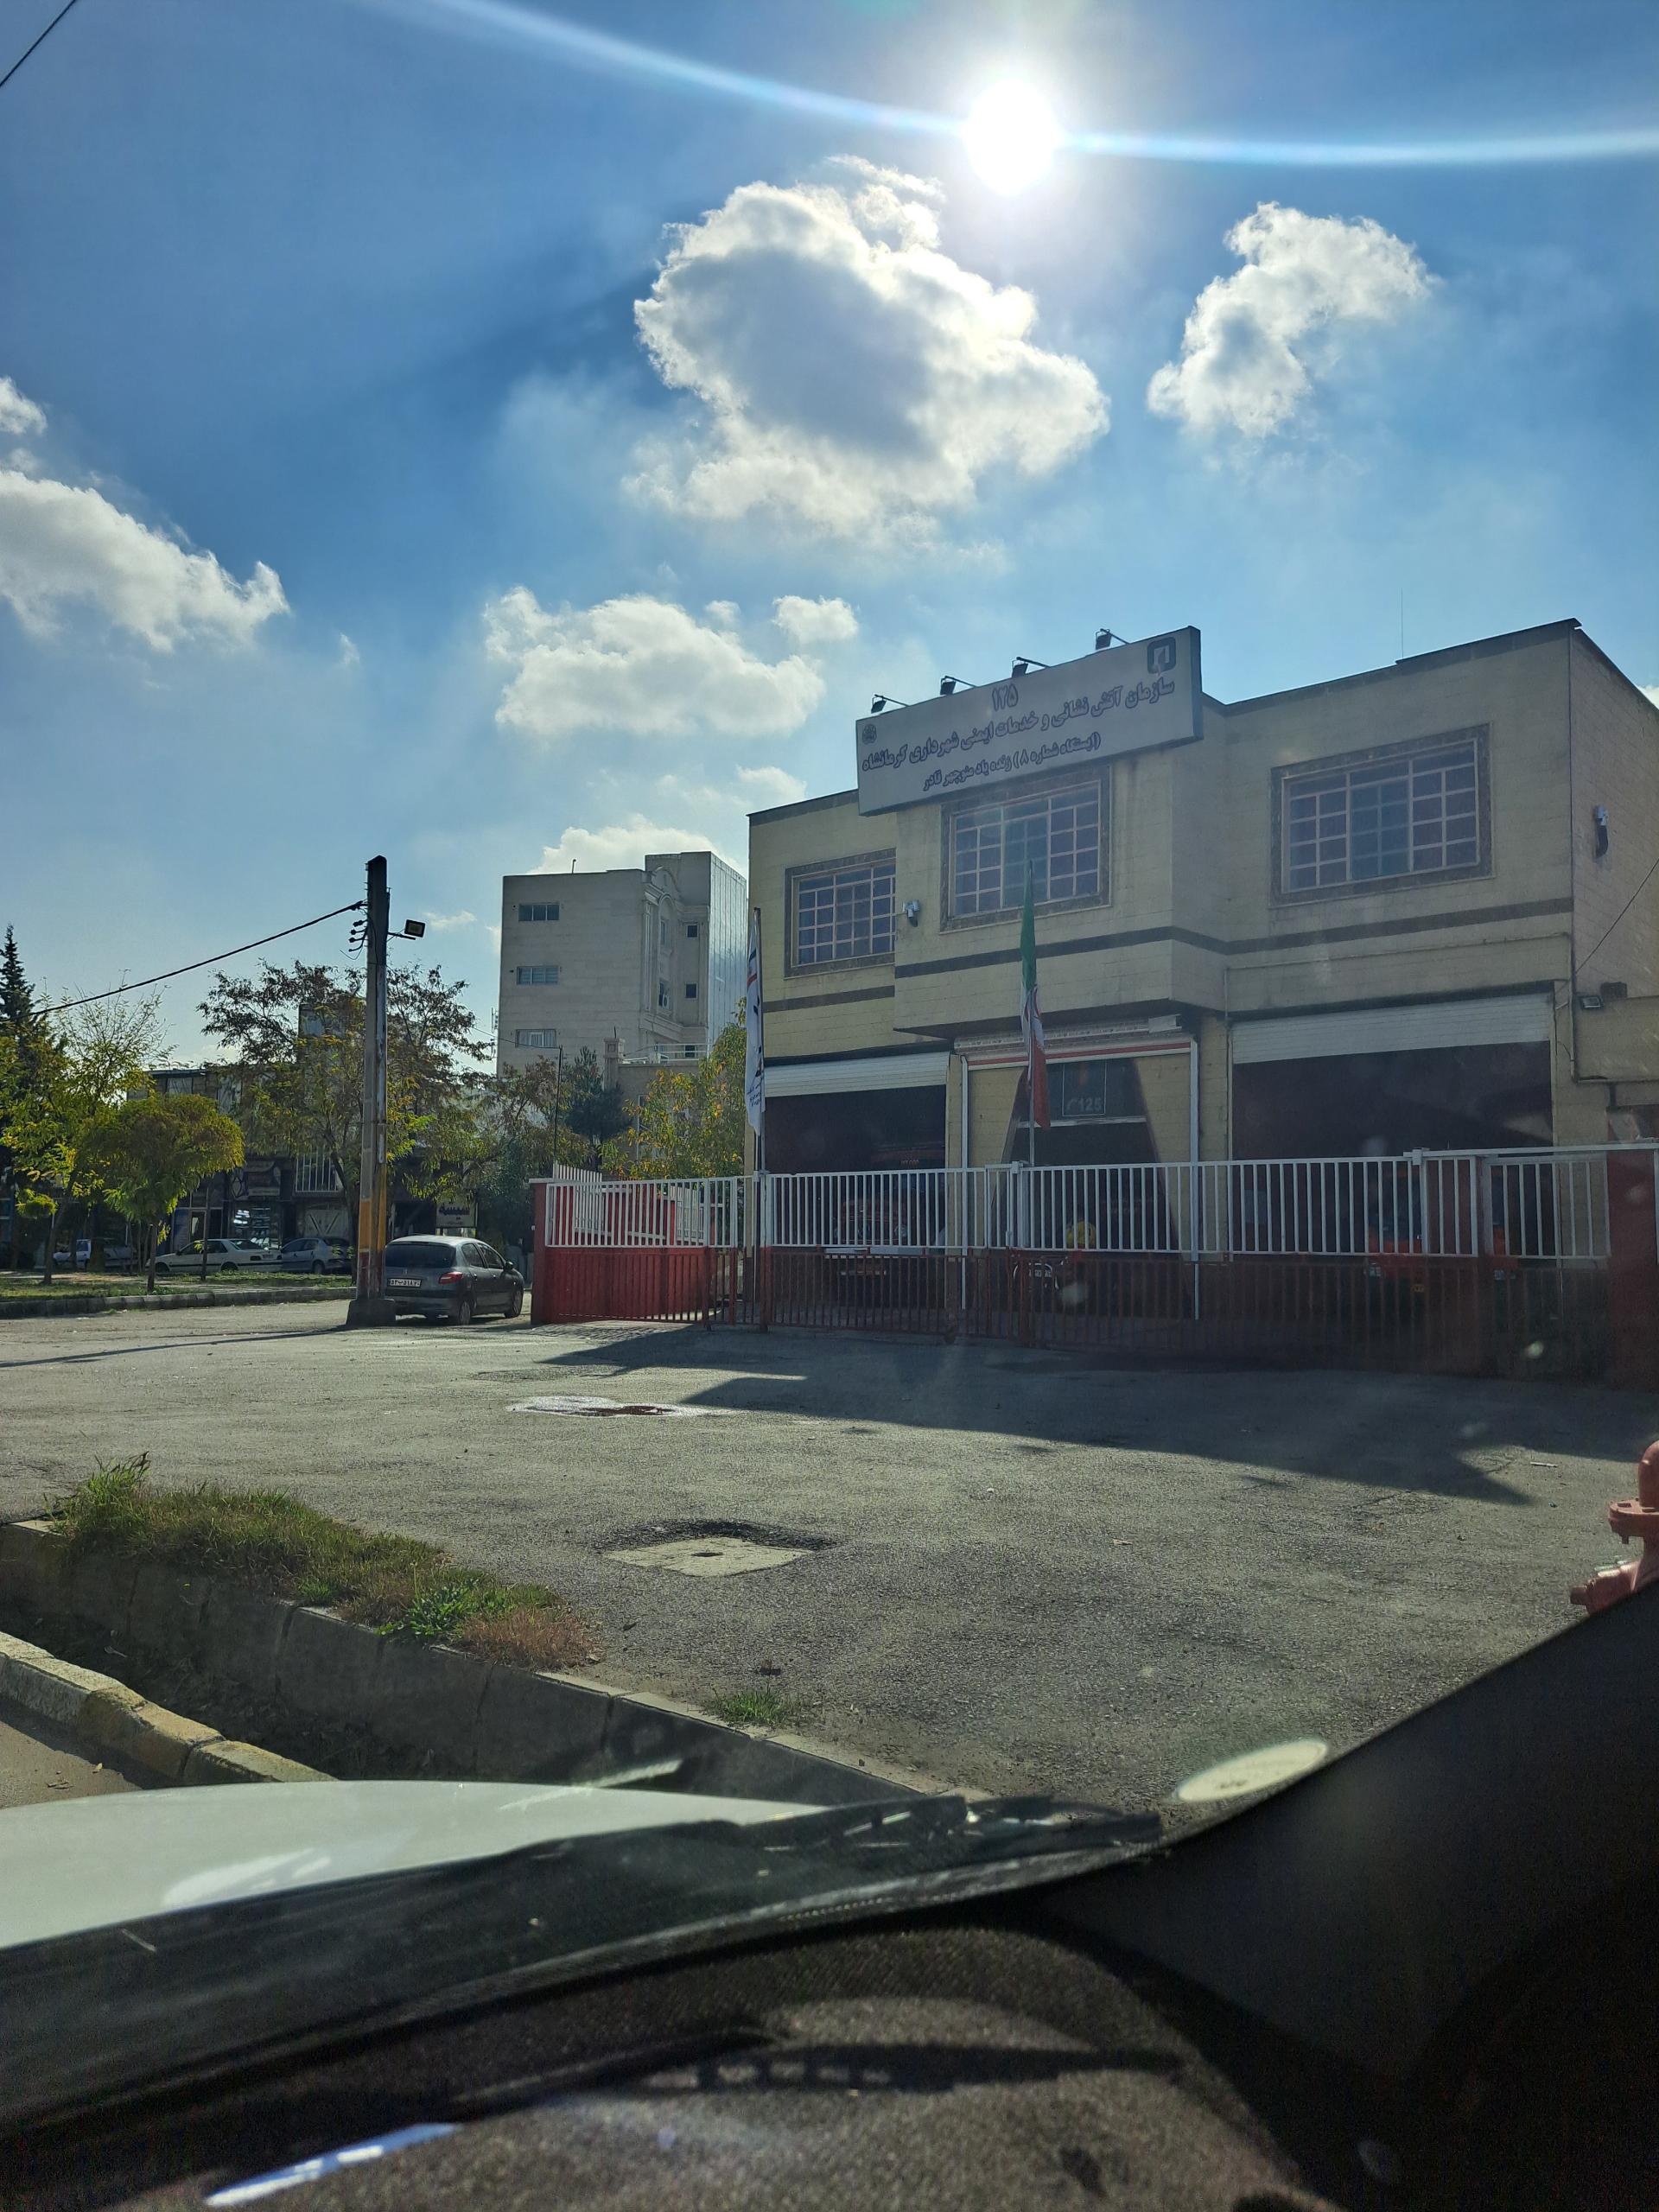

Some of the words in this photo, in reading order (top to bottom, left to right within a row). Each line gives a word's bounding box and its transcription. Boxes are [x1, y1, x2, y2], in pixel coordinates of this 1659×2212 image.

[992, 683, 1020, 712] ۱۲۵
[1090, 685, 1123, 718] آتش
[1125, 677, 1175, 709] سازمان
[995, 710, 1039, 737] خدمات
[1040, 714, 1050, 732] و
[1051, 696, 1090, 728] نشانی
[909, 731, 960, 764] شهرداری
[961, 721, 995, 751] ایمنی
[861, 744, 909, 772] کرمانشاه
[975, 759, 989, 776] یاد
